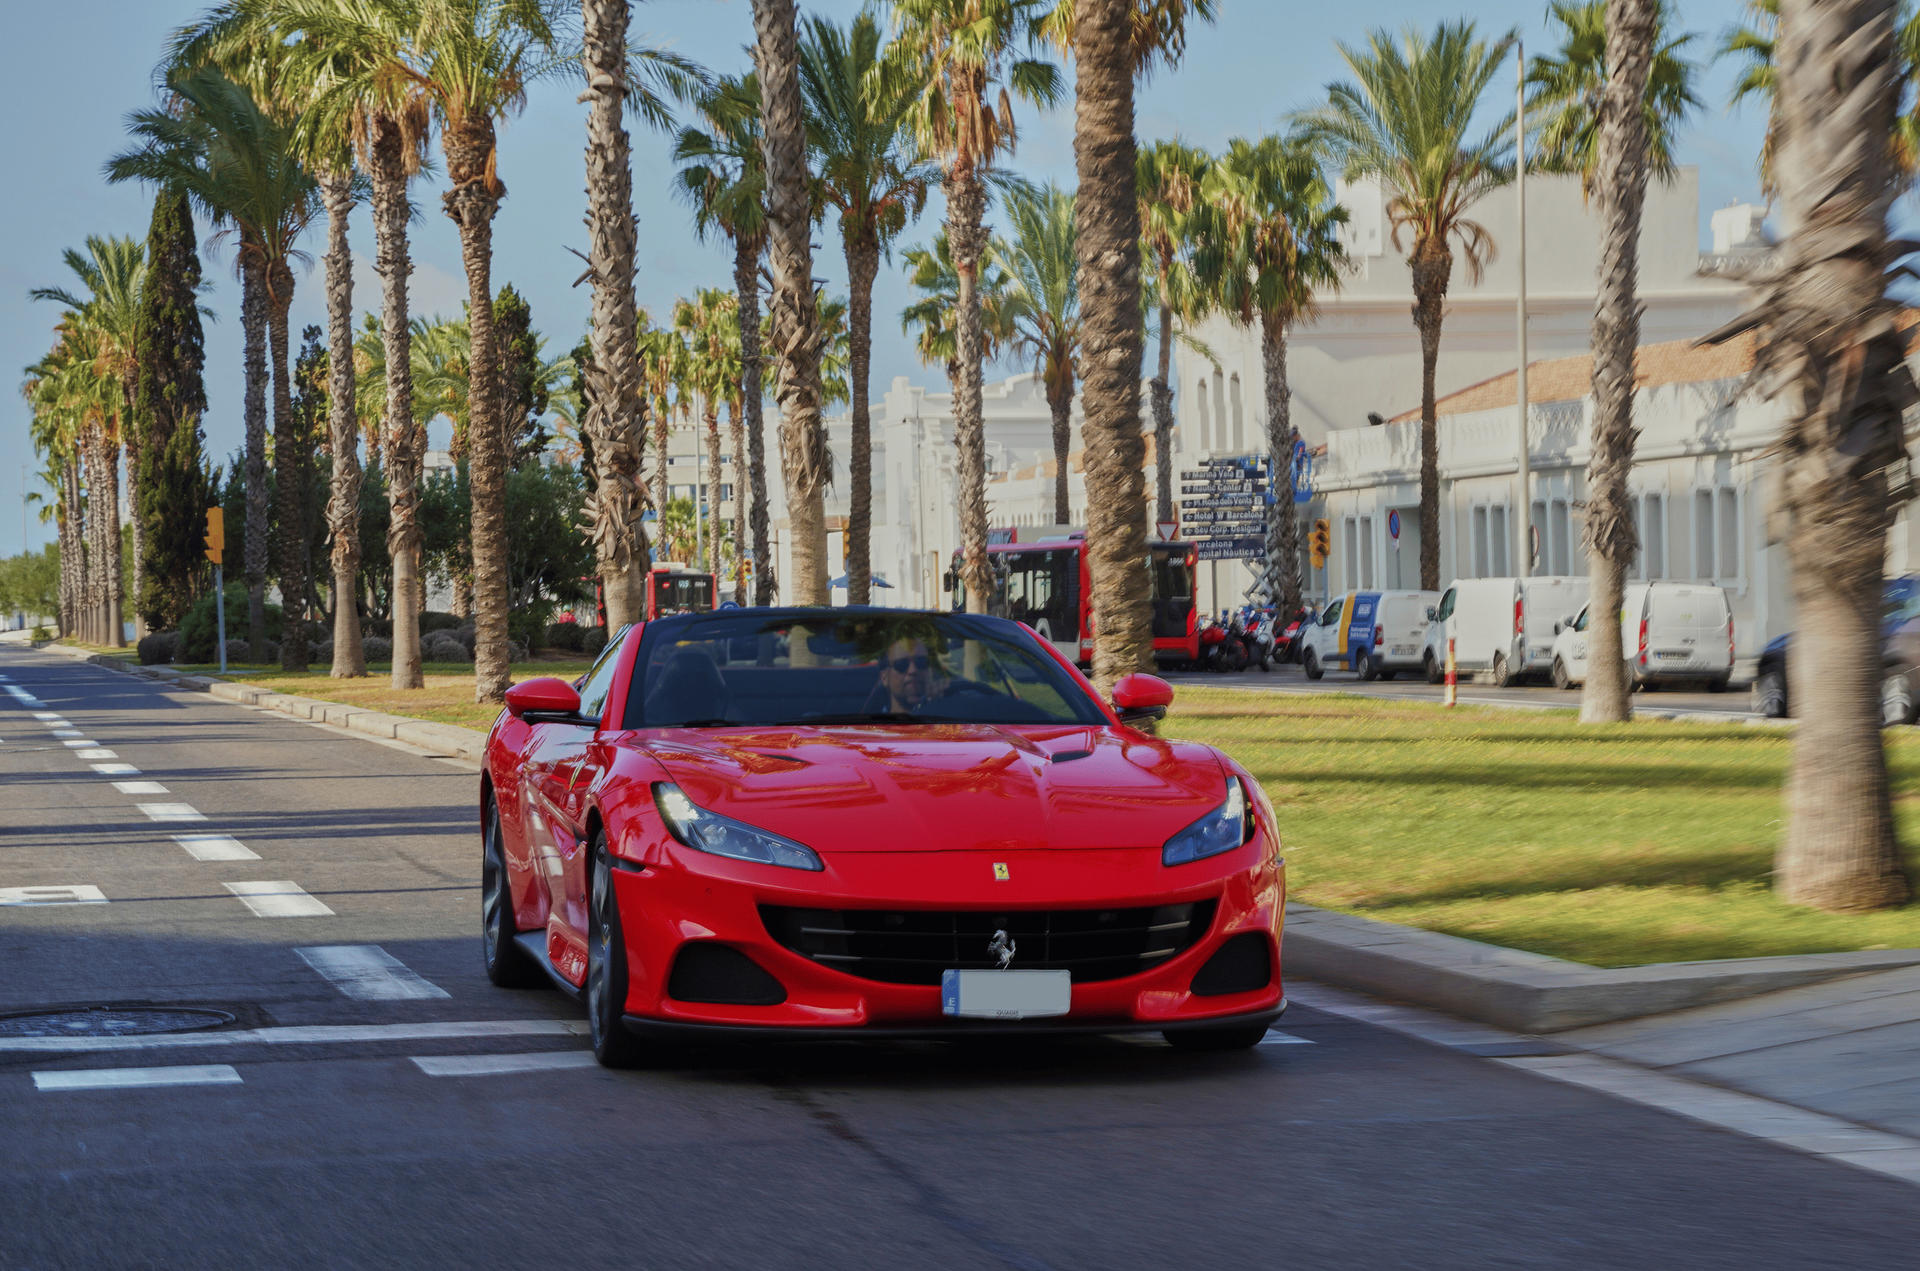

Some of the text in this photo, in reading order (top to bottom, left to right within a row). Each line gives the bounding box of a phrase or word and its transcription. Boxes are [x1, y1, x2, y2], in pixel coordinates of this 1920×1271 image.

[1217, 483, 1241, 492] Center
[1194, 510, 1264, 520] Hotel W Barcelona
[1231, 524, 1262, 534] Desigual
[1198, 540, 1233, 548] arcelona
[1198, 549, 1221, 558] apital
